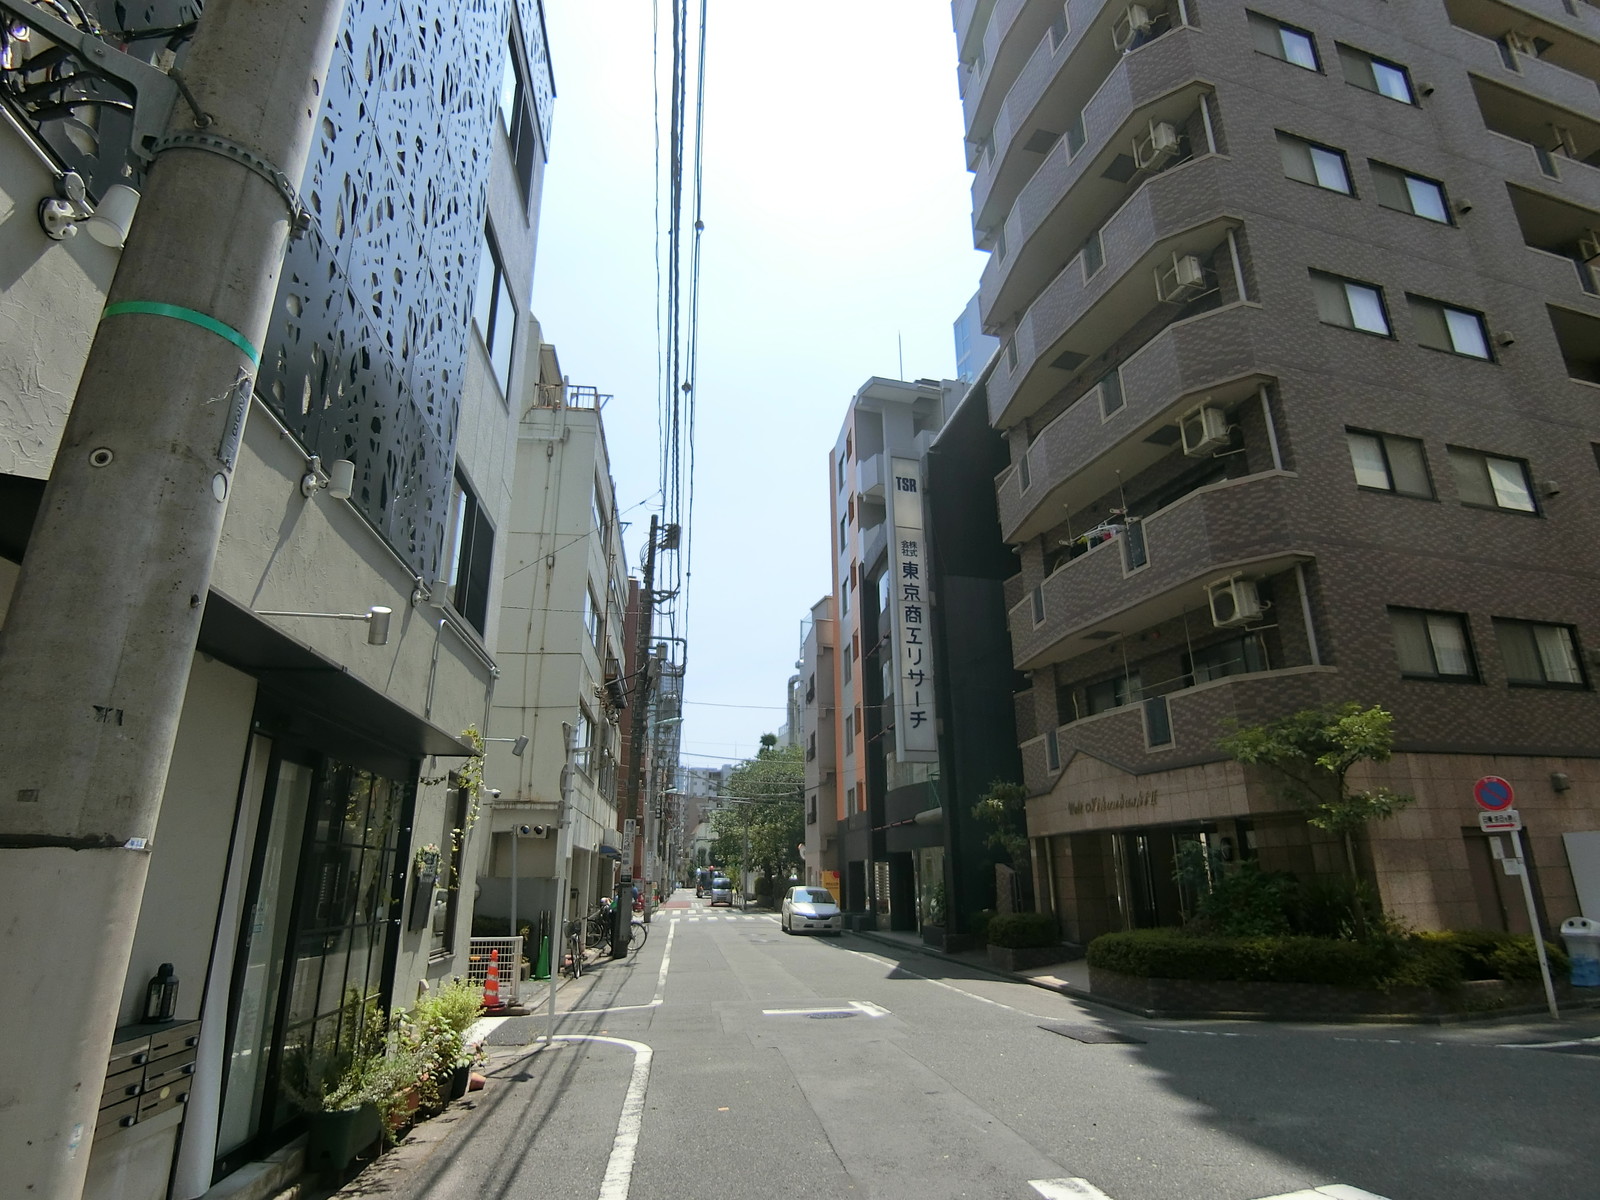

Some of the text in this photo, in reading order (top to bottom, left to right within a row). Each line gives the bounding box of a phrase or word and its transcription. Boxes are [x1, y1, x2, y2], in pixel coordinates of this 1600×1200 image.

[895, 476, 917, 493] TSR
[902, 560, 928, 729] 東京商工リサーチ
